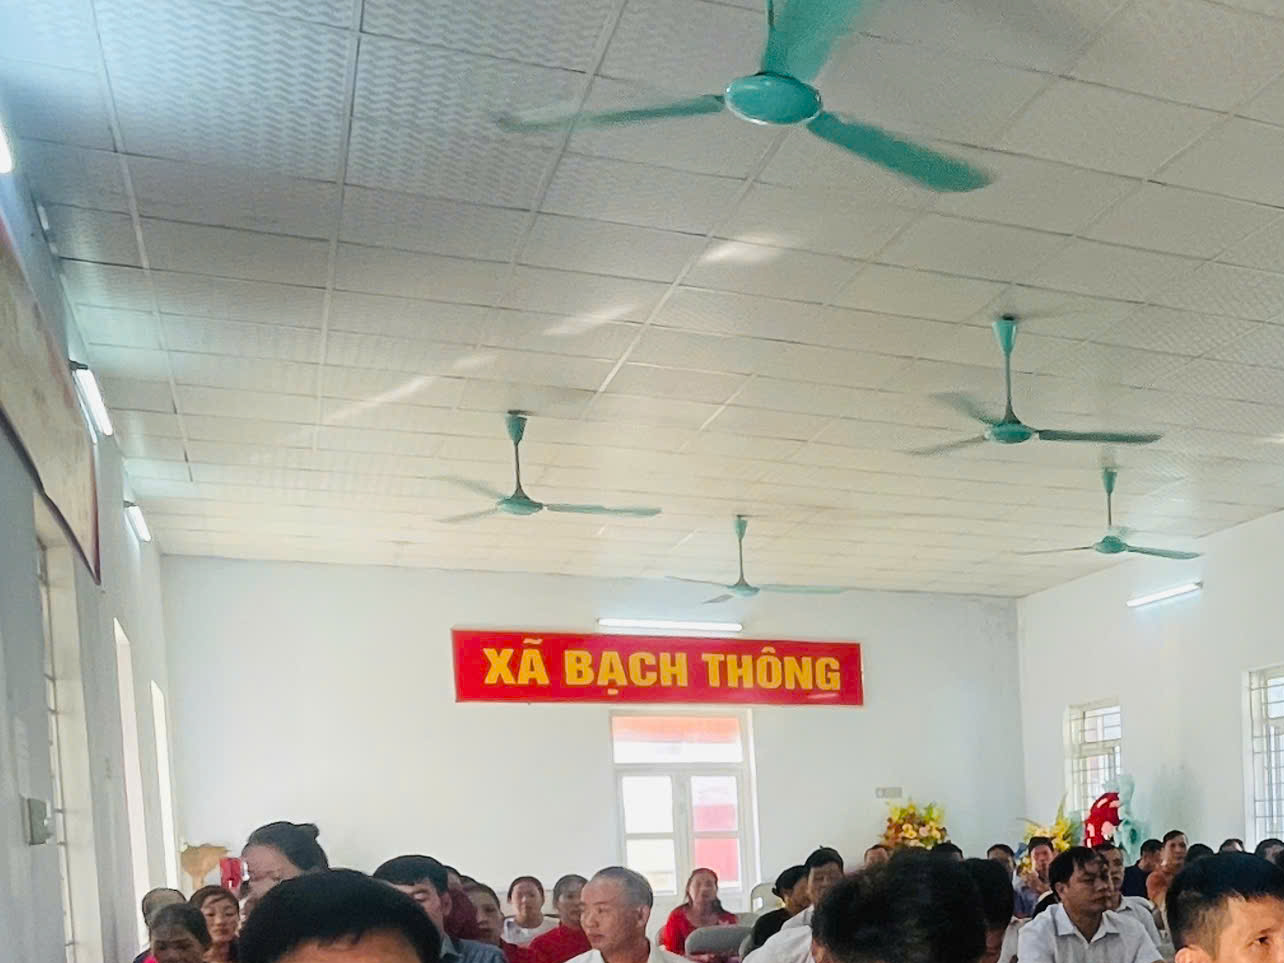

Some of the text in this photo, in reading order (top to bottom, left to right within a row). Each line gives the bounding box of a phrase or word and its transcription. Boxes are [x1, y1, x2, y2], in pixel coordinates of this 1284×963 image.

[483, 638, 841, 695] XÃ BẠCH THÔNG
